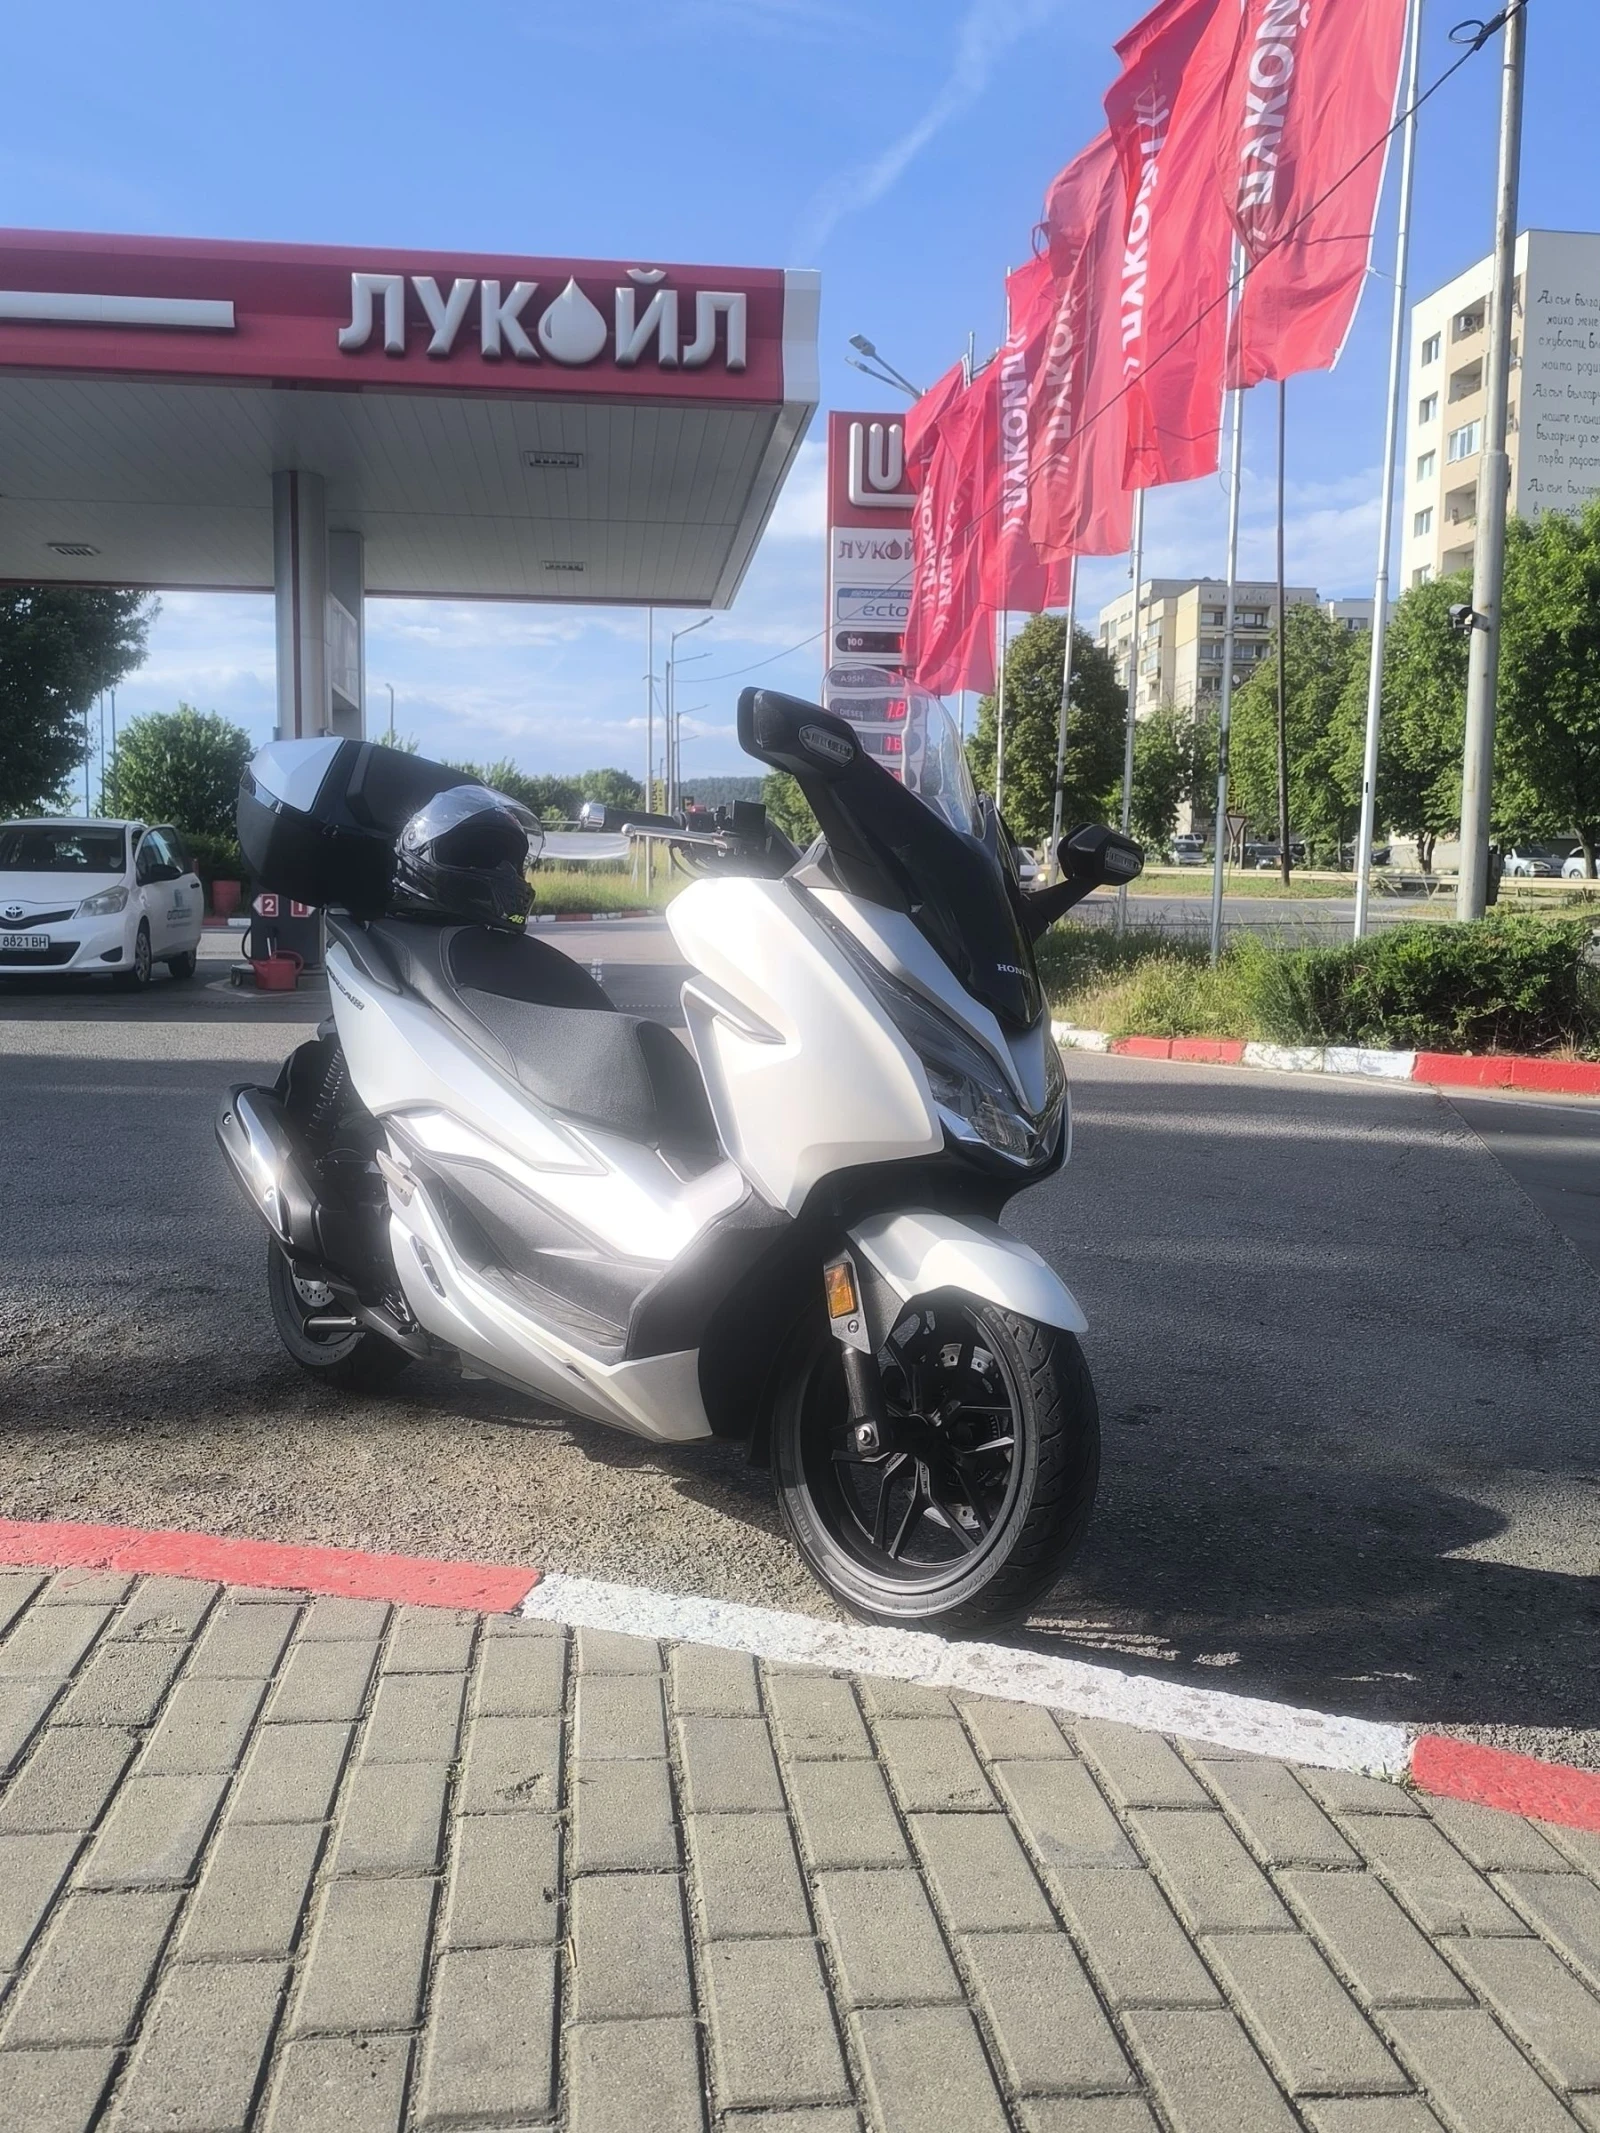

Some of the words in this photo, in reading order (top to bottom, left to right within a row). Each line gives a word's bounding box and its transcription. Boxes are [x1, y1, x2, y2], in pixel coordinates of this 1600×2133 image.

[338, 267, 748, 370] ЛУКОЙЛ
[838, 537, 915, 560] ЛУКОЙ
[885, 701, 906, 718] 1.8
[264, 899, 275, 912] 2
[508, 914, 525, 924] 46
[3, 936, 29, 947] 8821
